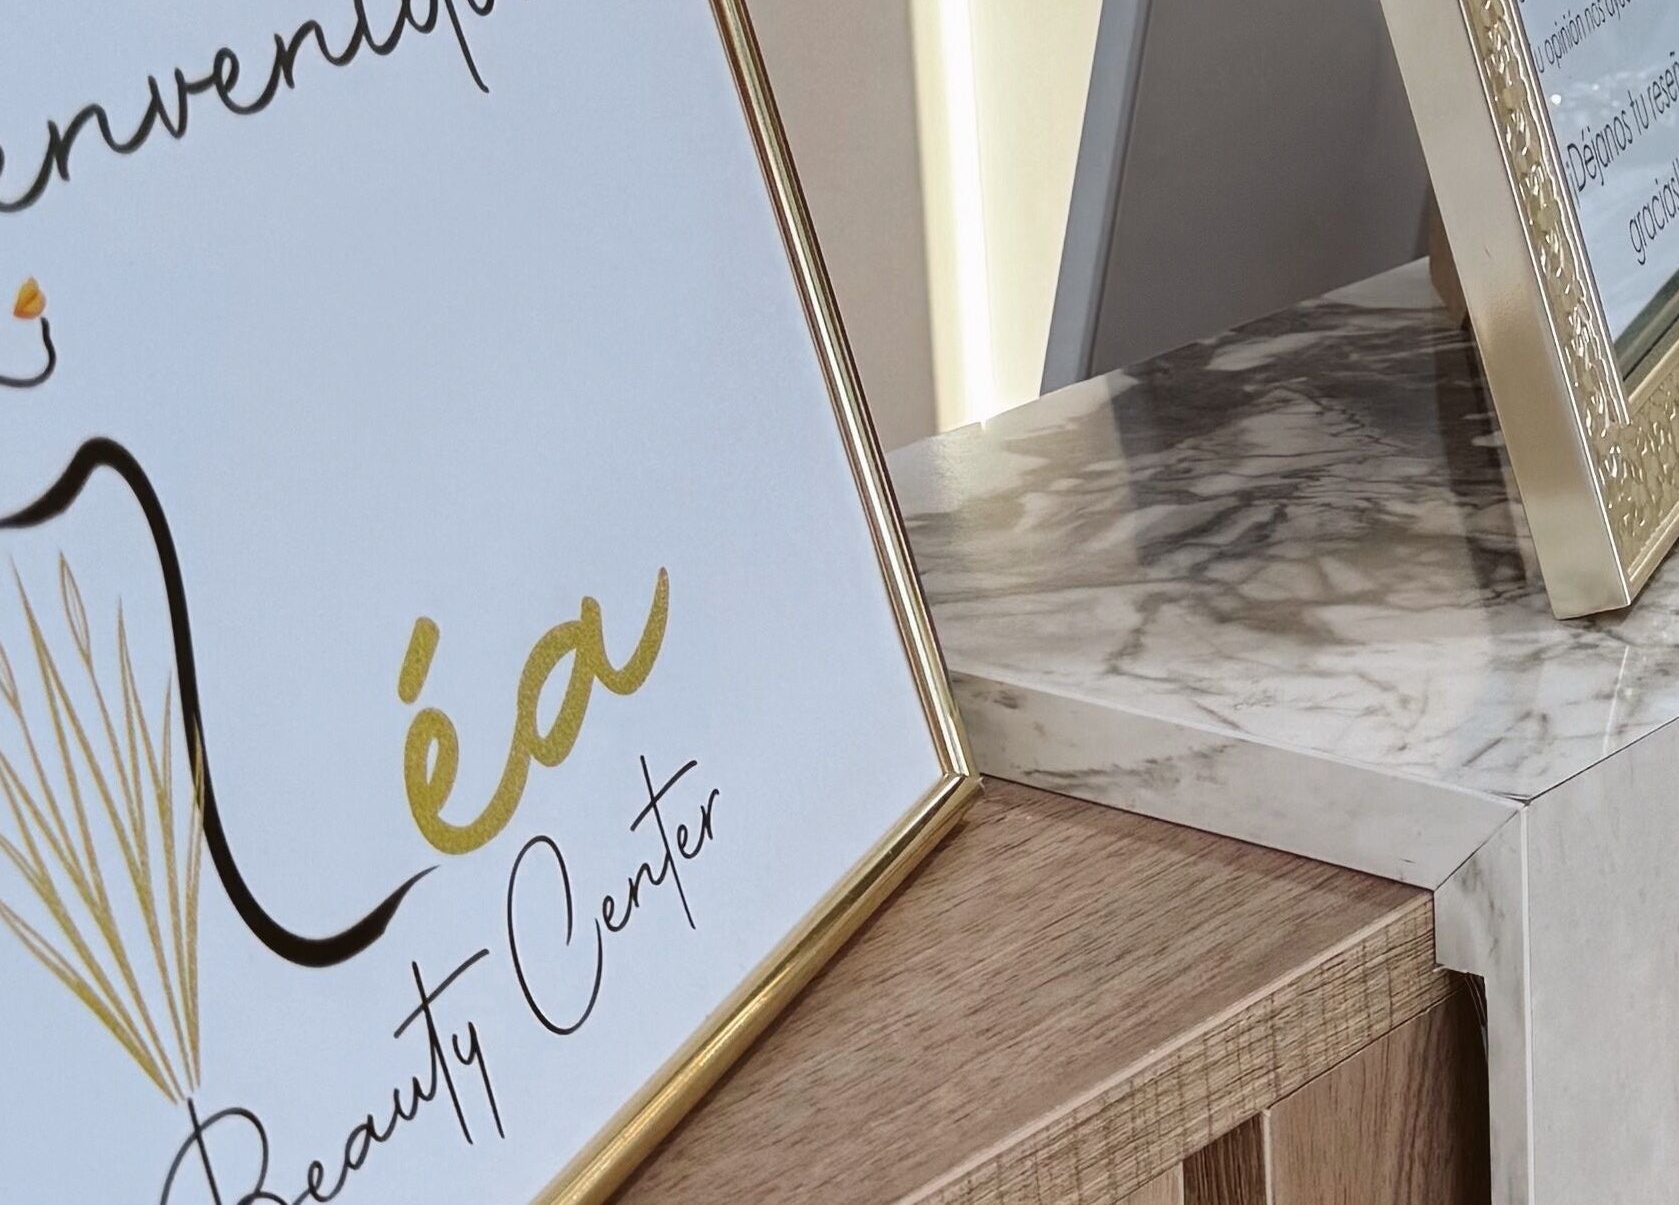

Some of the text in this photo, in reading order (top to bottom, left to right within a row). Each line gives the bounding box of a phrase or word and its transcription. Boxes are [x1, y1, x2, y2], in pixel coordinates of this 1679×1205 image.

[1544, 8, 1587, 69] opinión
[1628, 89, 1650, 135] tu
[507, 755, 720, 1035] Center
